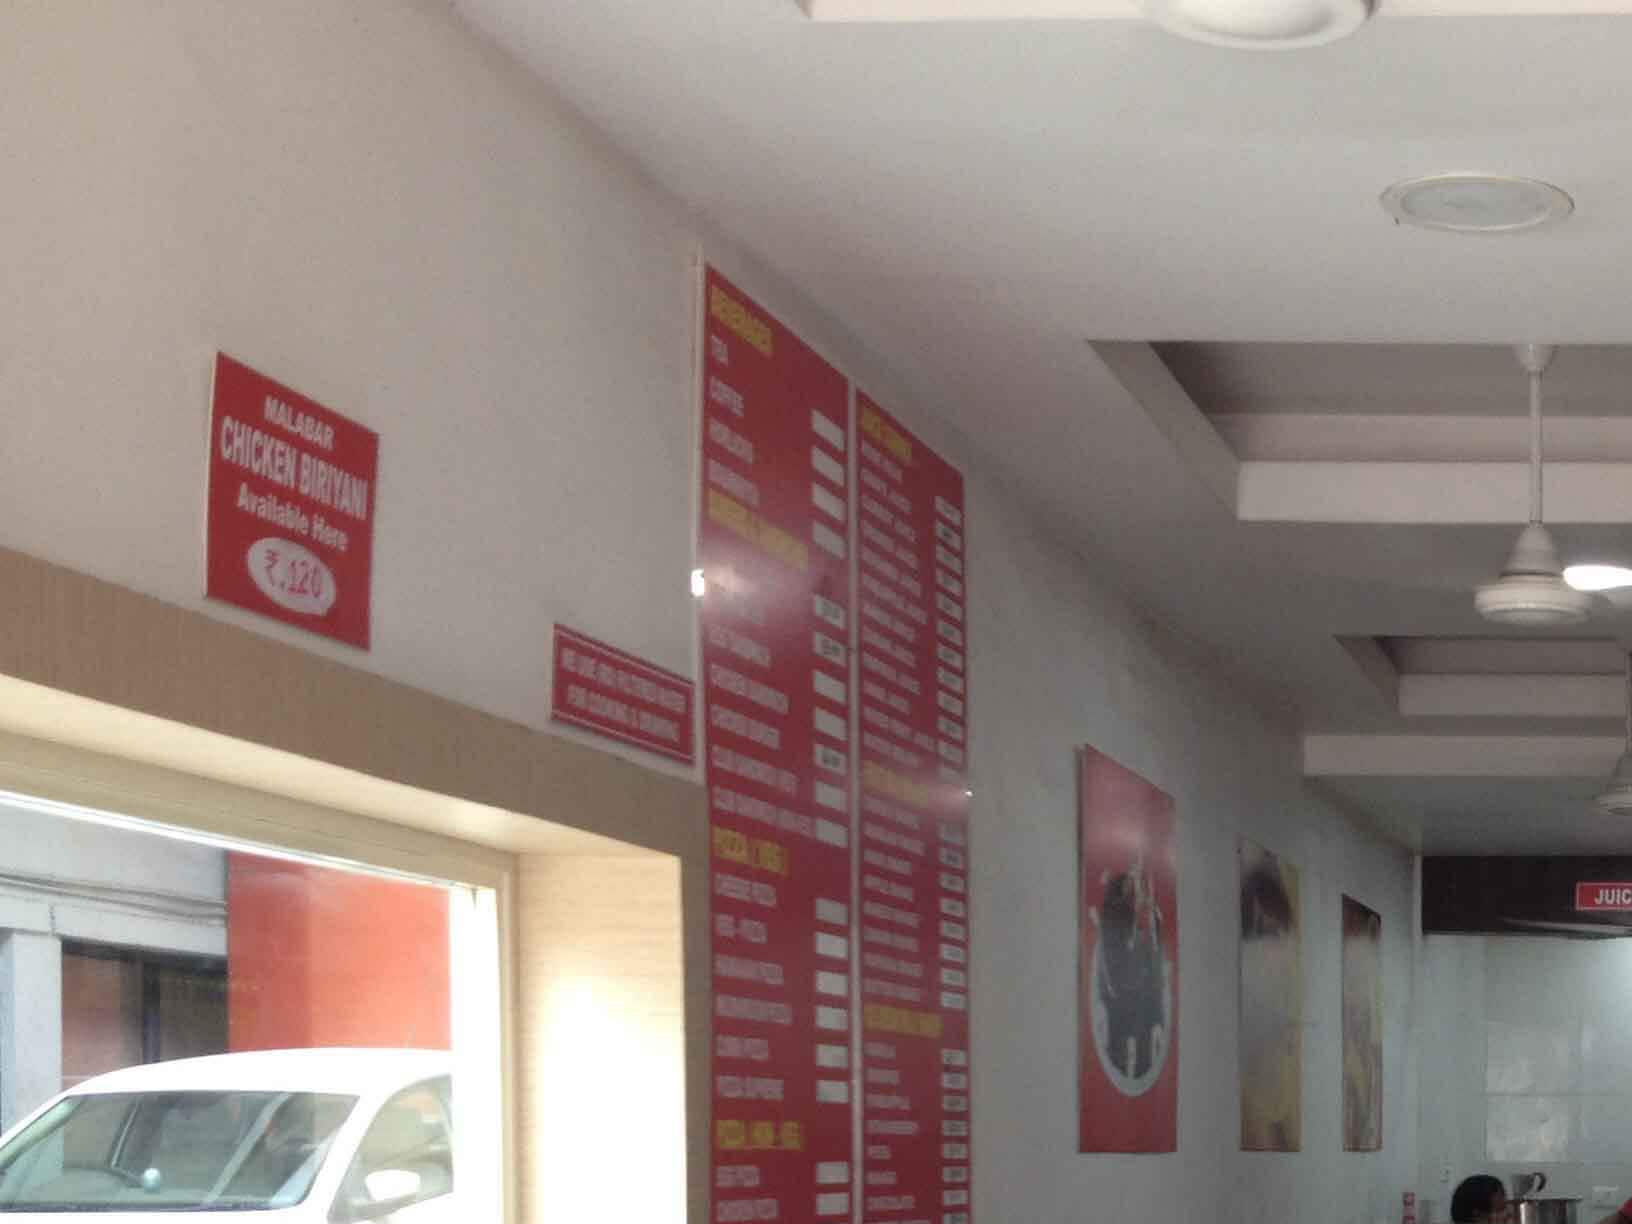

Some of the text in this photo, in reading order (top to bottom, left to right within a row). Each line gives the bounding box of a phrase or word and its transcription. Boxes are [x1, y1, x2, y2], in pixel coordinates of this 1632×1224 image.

[264, 396, 334, 450] MALABAR
[220, 415, 368, 520] CHICKEN BIRIYANI
[237, 482, 349, 553] Available Here
